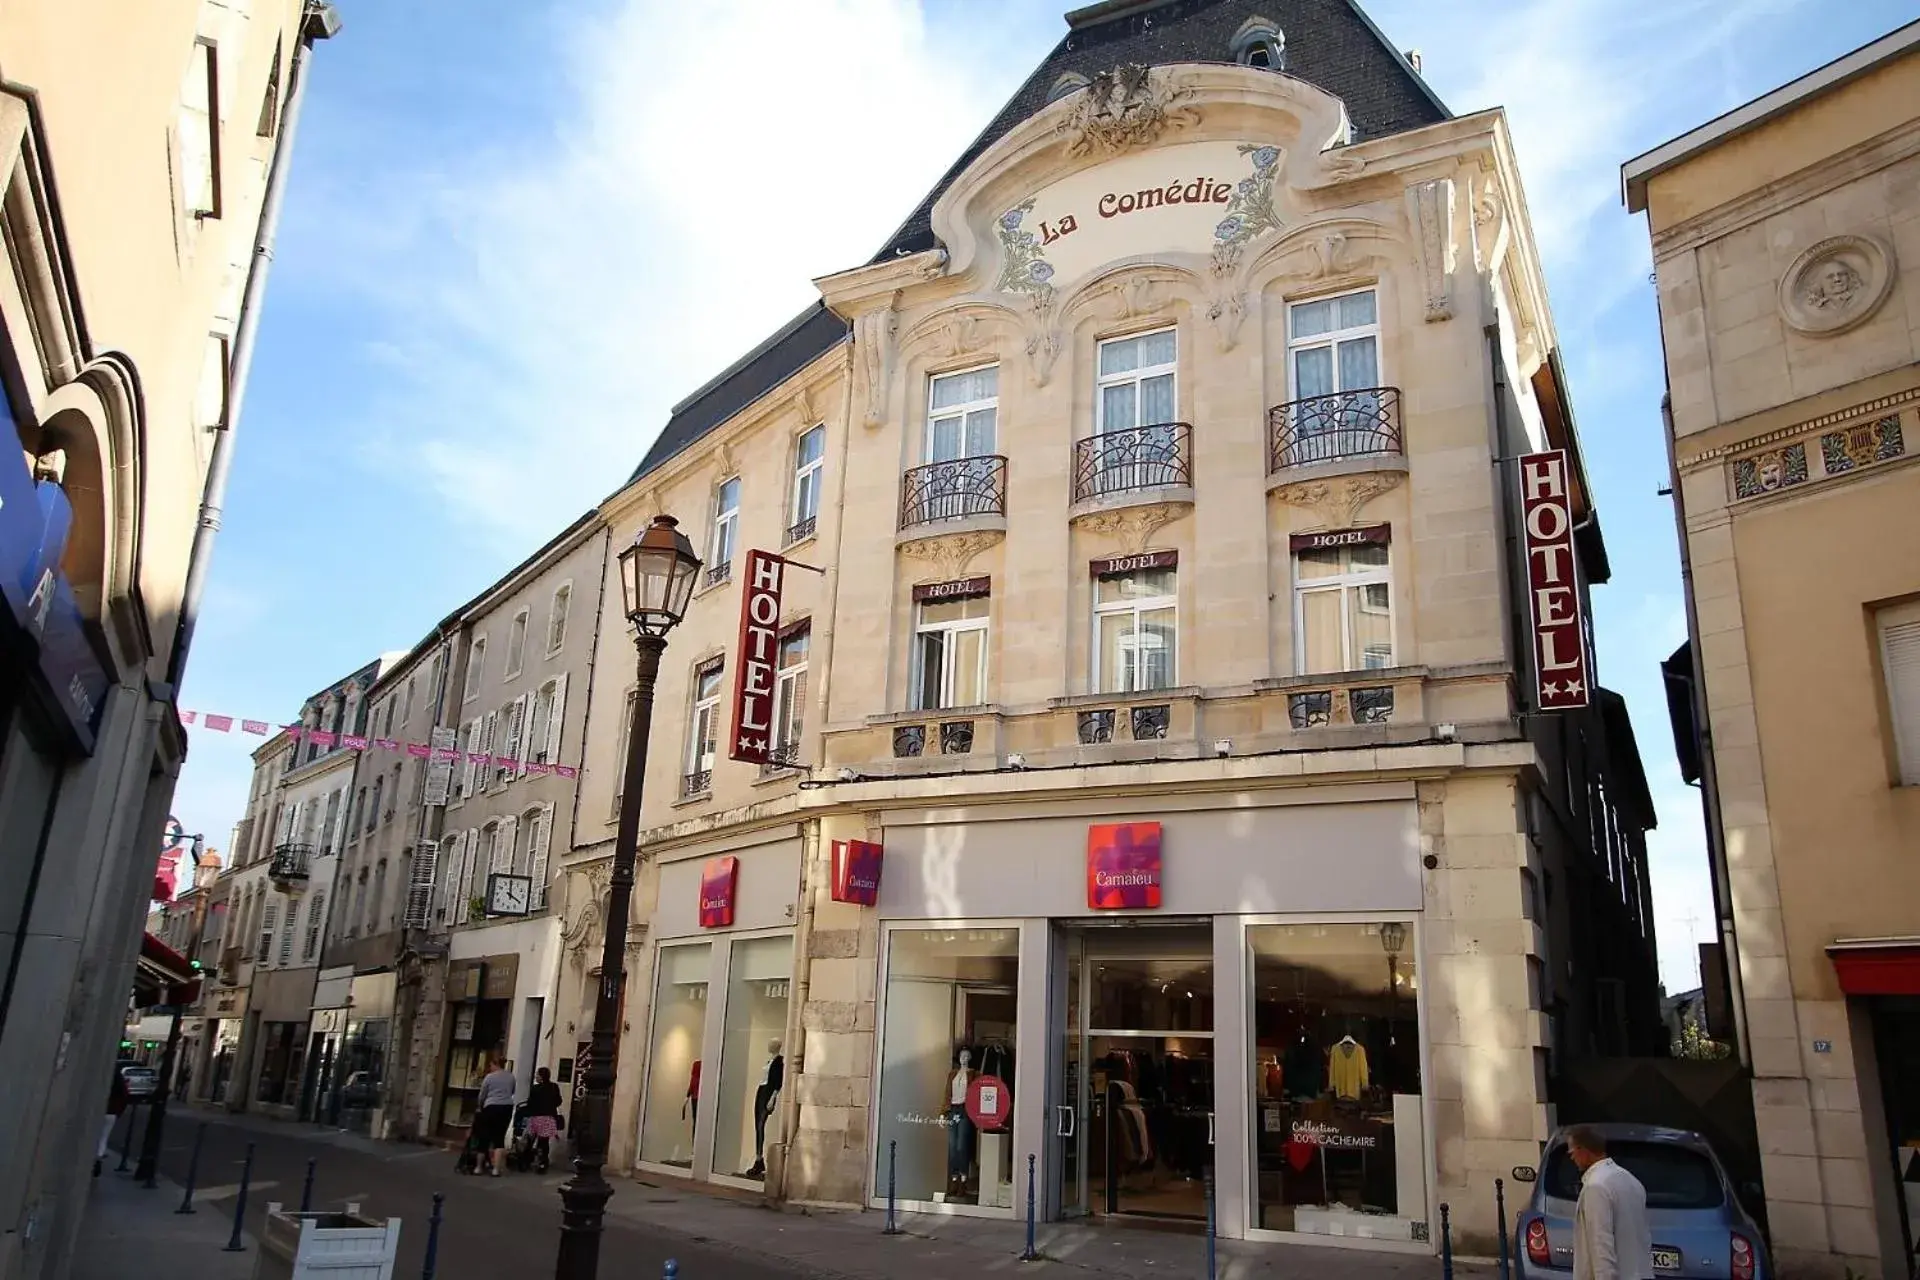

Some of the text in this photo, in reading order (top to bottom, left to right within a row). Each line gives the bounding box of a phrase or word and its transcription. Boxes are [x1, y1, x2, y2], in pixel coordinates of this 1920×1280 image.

[1039, 177, 1232, 246] La Comédie
[1312, 531, 1367, 547] HOTEL
[1109, 554, 1159, 572] HOTEL
[1524, 459, 1579, 672] HOTEL
[929, 580, 974, 597] HOTEL
[740, 556, 781, 732] HOTEL
[1292, 1119, 1340, 1134] Collection
[1293, 1133, 1375, 1148] 100% CACHEMIRE
